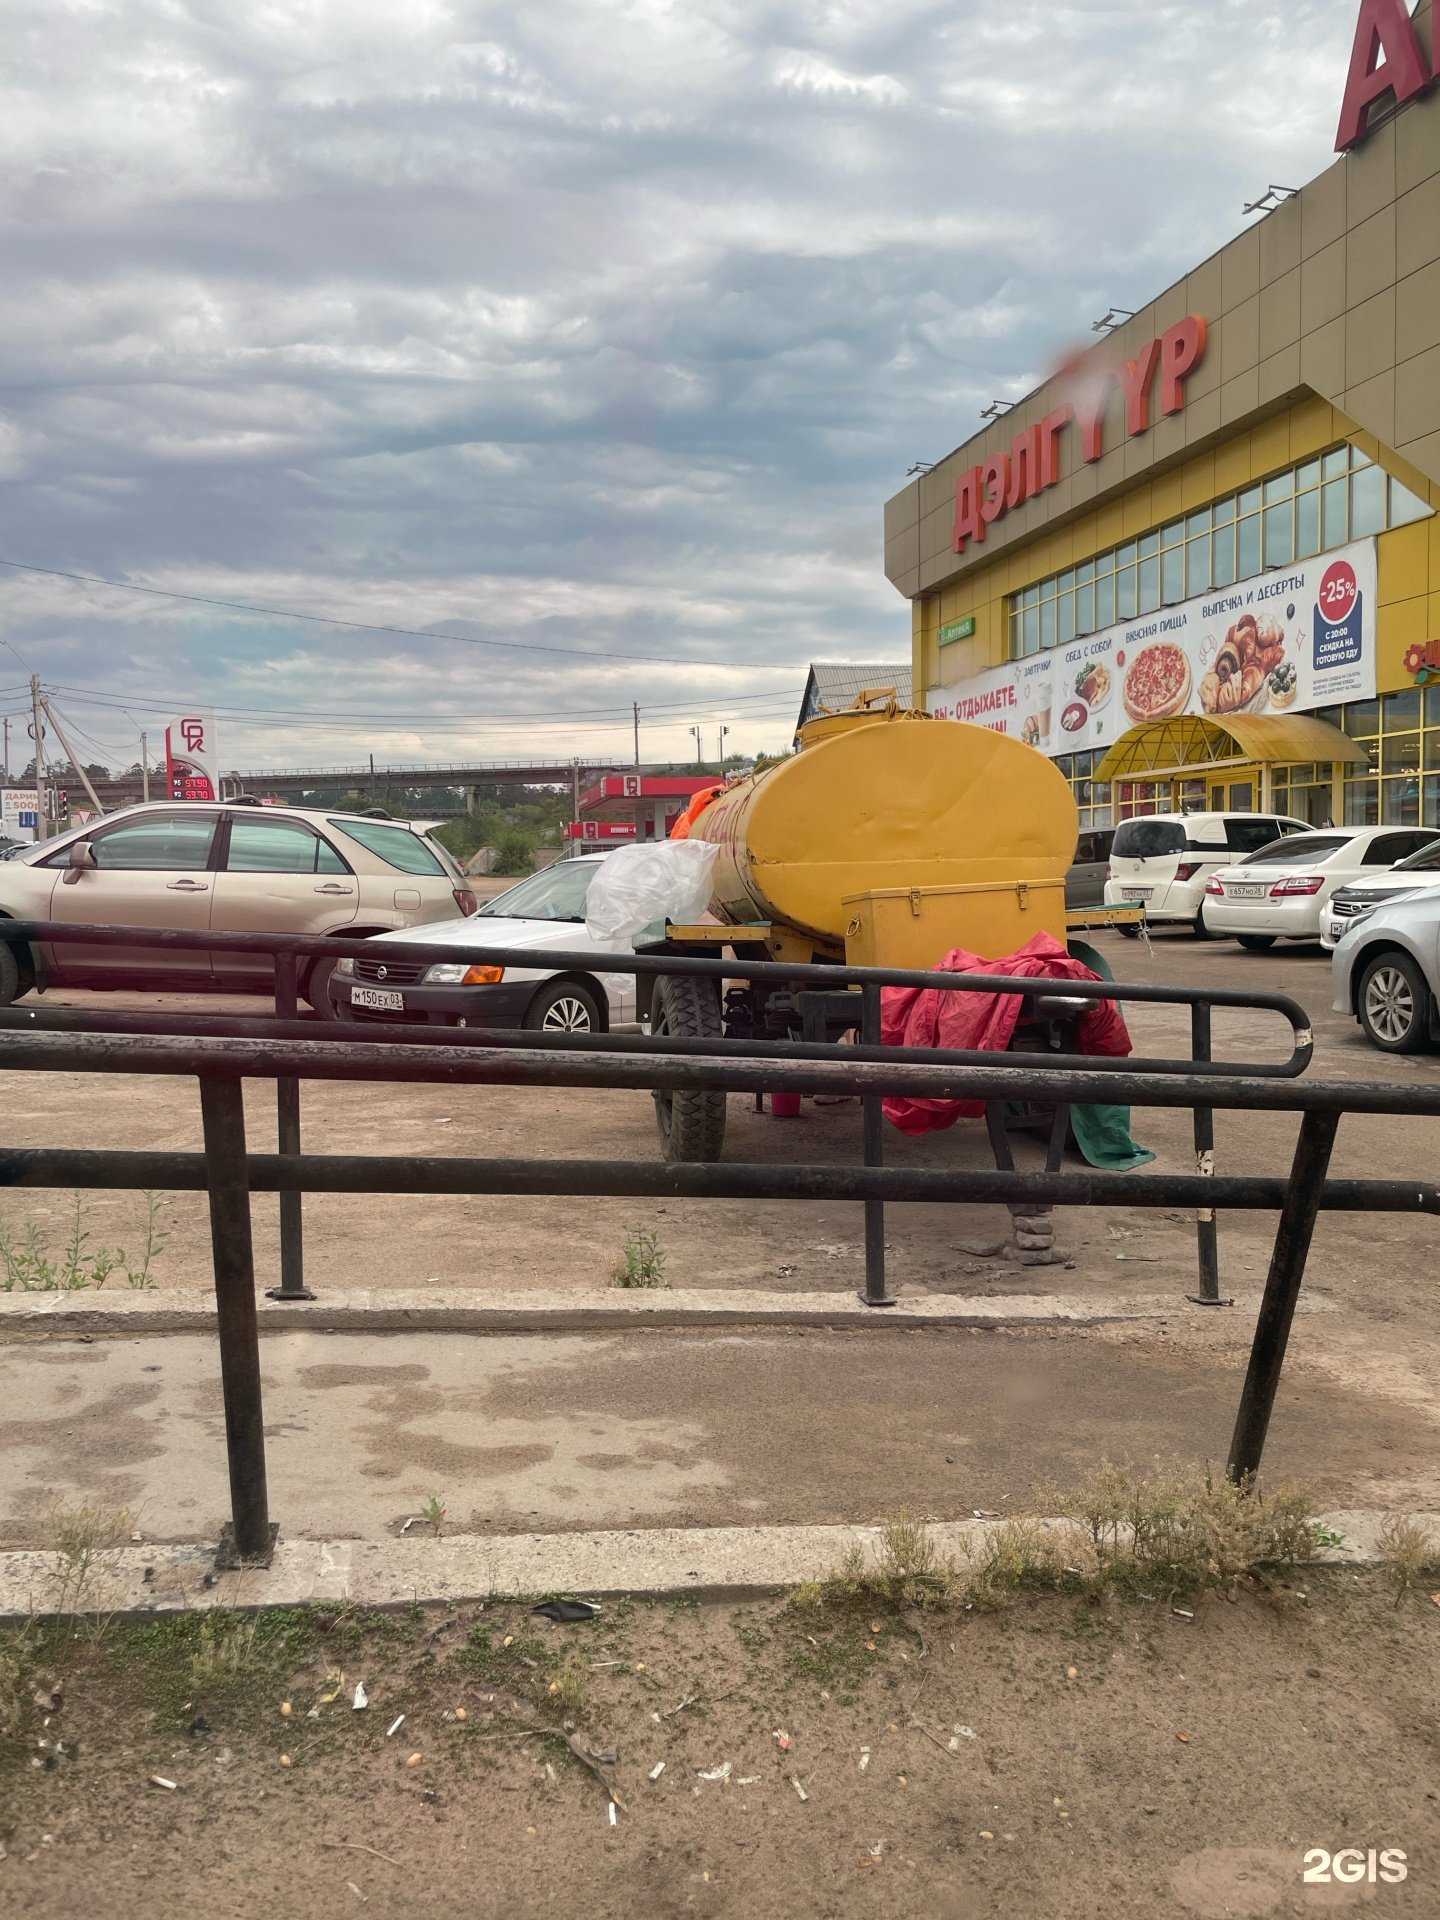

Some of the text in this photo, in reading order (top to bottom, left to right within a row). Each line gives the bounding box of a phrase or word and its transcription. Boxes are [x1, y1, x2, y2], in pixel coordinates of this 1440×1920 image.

[1202, 573, 1305, 618] ВЫПЕЧКА И ДЕСЕРТЫ
[1320, 577, 1356, 603] -25%
[1125, 623, 1158, 643] ВКУСНАЯ
[1319, 637, 1354, 653] СКИДКА НА
[1316, 648, 1359, 666] ГОТОВУЮ ЕДУ
[955, 685, 1017, 720] ОТДЫХАЕТЕ,
